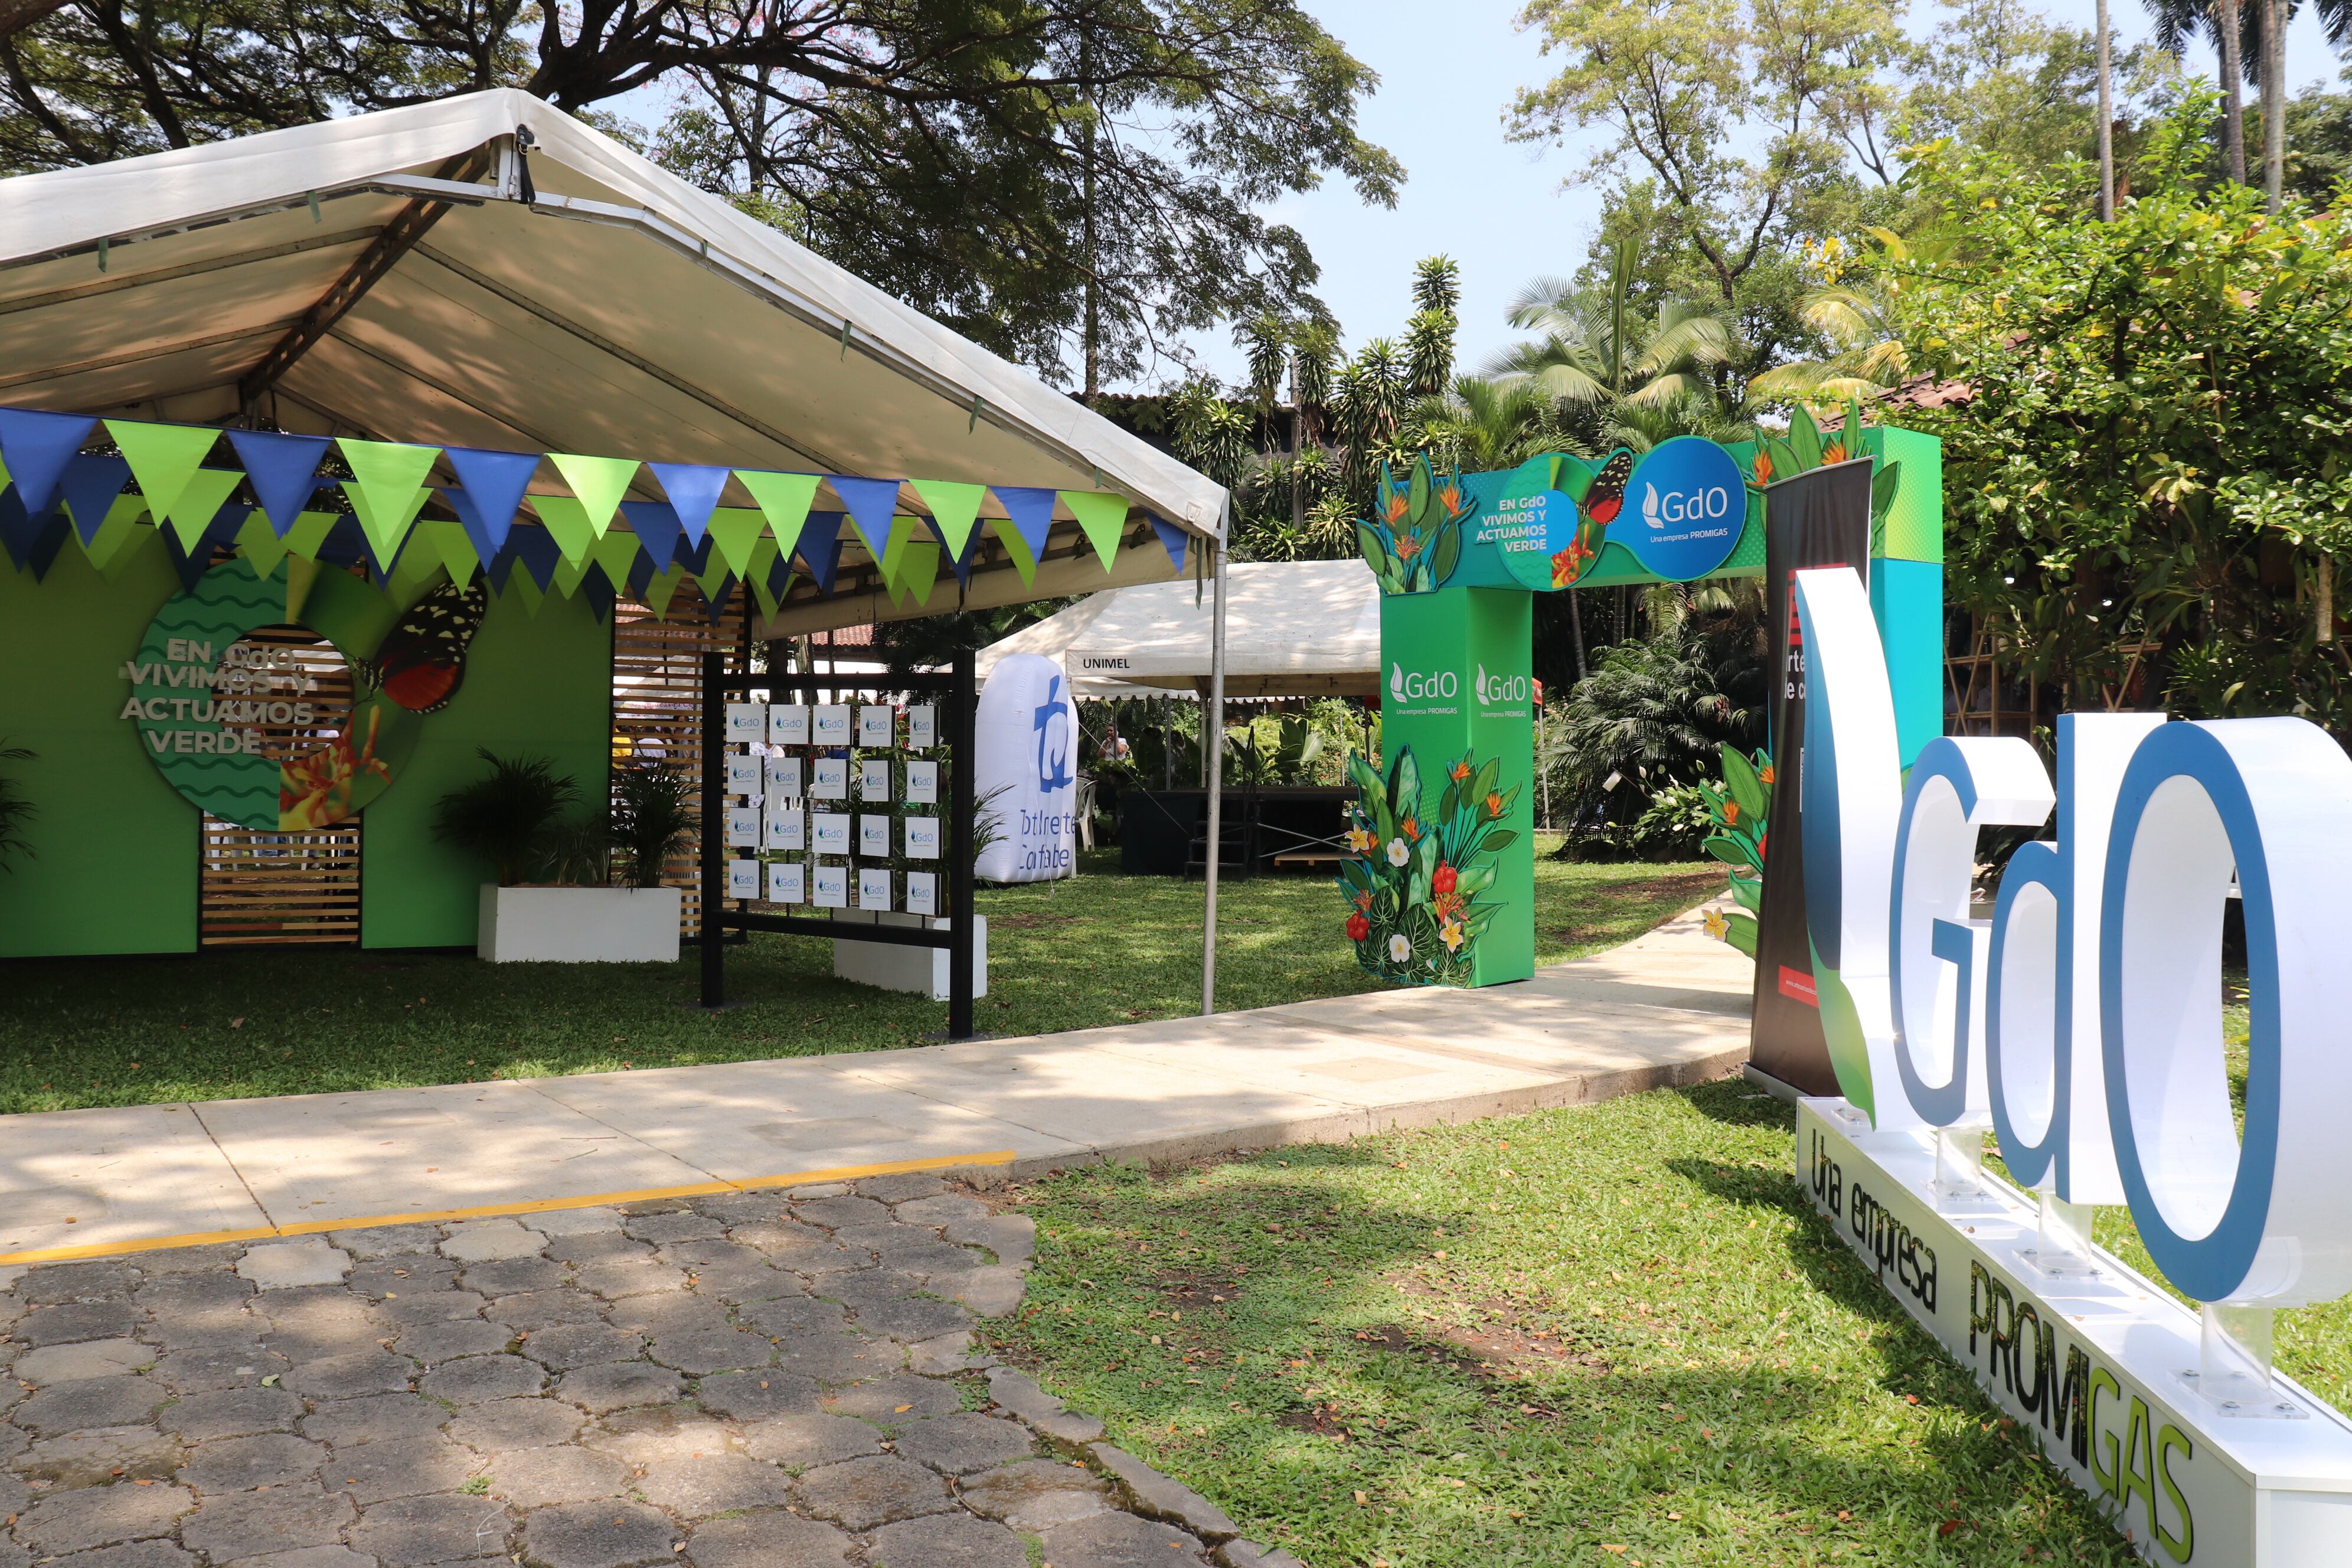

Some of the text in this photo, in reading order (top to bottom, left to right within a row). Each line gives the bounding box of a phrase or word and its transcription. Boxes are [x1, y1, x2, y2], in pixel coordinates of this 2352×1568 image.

[1500, 495, 1546, 511] EN GdO
[1662, 487, 1727, 522] GdO
[1482, 510, 1547, 527] VIVIMOS Y
[1476, 524, 1547, 541] ACTUAMOS
[1663, 534, 1688, 543] empresa
[1690, 528, 1728, 539] PROMIGAS
[1504, 538, 1547, 553] VERDE
[167, 638, 295, 671] EN GdO
[1083, 658, 1130, 669] UNIMEL
[126, 661, 313, 695] VIVIMOS Y
[1406, 671, 1458, 698] GdO
[1488, 675, 1526, 701] GdO
[119, 697, 314, 726] ACTUAMOS
[740, 718, 759, 727] GdO
[782, 719, 802, 729] GdO
[825, 719, 844, 729] GdO
[870, 720, 887, 730] GdO
[917, 721, 929, 731] GdO
[147, 730, 262, 754] VERDE
[738, 769, 755, 778] GdO
[779, 772, 795, 782] GdO
[824, 773, 840, 782] GdO
[870, 776, 883, 786] GdO
[916, 776, 932, 786] GdO
[739, 822, 754, 832] GdO
[780, 824, 798, 834] GdO
[824, 829, 843, 838] GdO
[869, 829, 883, 839] GdO
[916, 832, 933, 842] GdO
[739, 876, 754, 884] GdO
[780, 878, 798, 887] GdO
[824, 882, 841, 892] GdO
[868, 885, 884, 894] GdO
[915, 888, 930, 898] GdO
[1889, 712, 2282, 1302] GdO
[1812, 1129, 2194, 1564] Una empresa PROMIGAS
